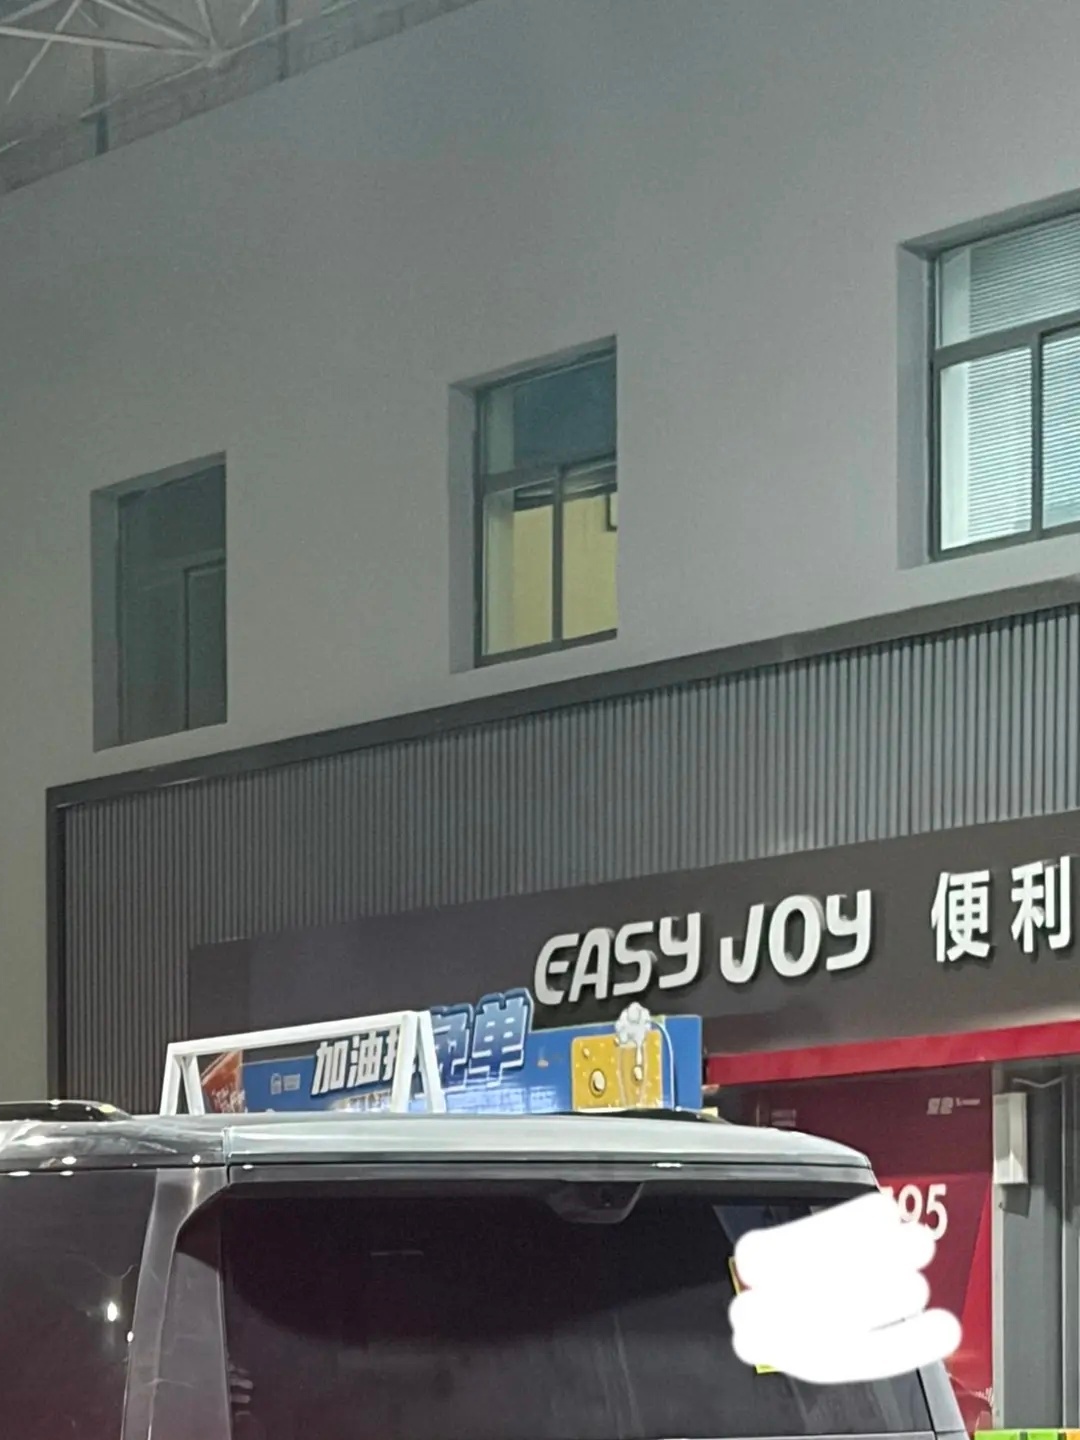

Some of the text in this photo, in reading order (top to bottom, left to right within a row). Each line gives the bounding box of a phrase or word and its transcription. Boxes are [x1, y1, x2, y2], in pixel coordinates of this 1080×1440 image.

[534, 889, 872, 1006] EASY JOY
[930, 856, 1072, 963] 便利
[882, 1183, 948, 1241] 95
